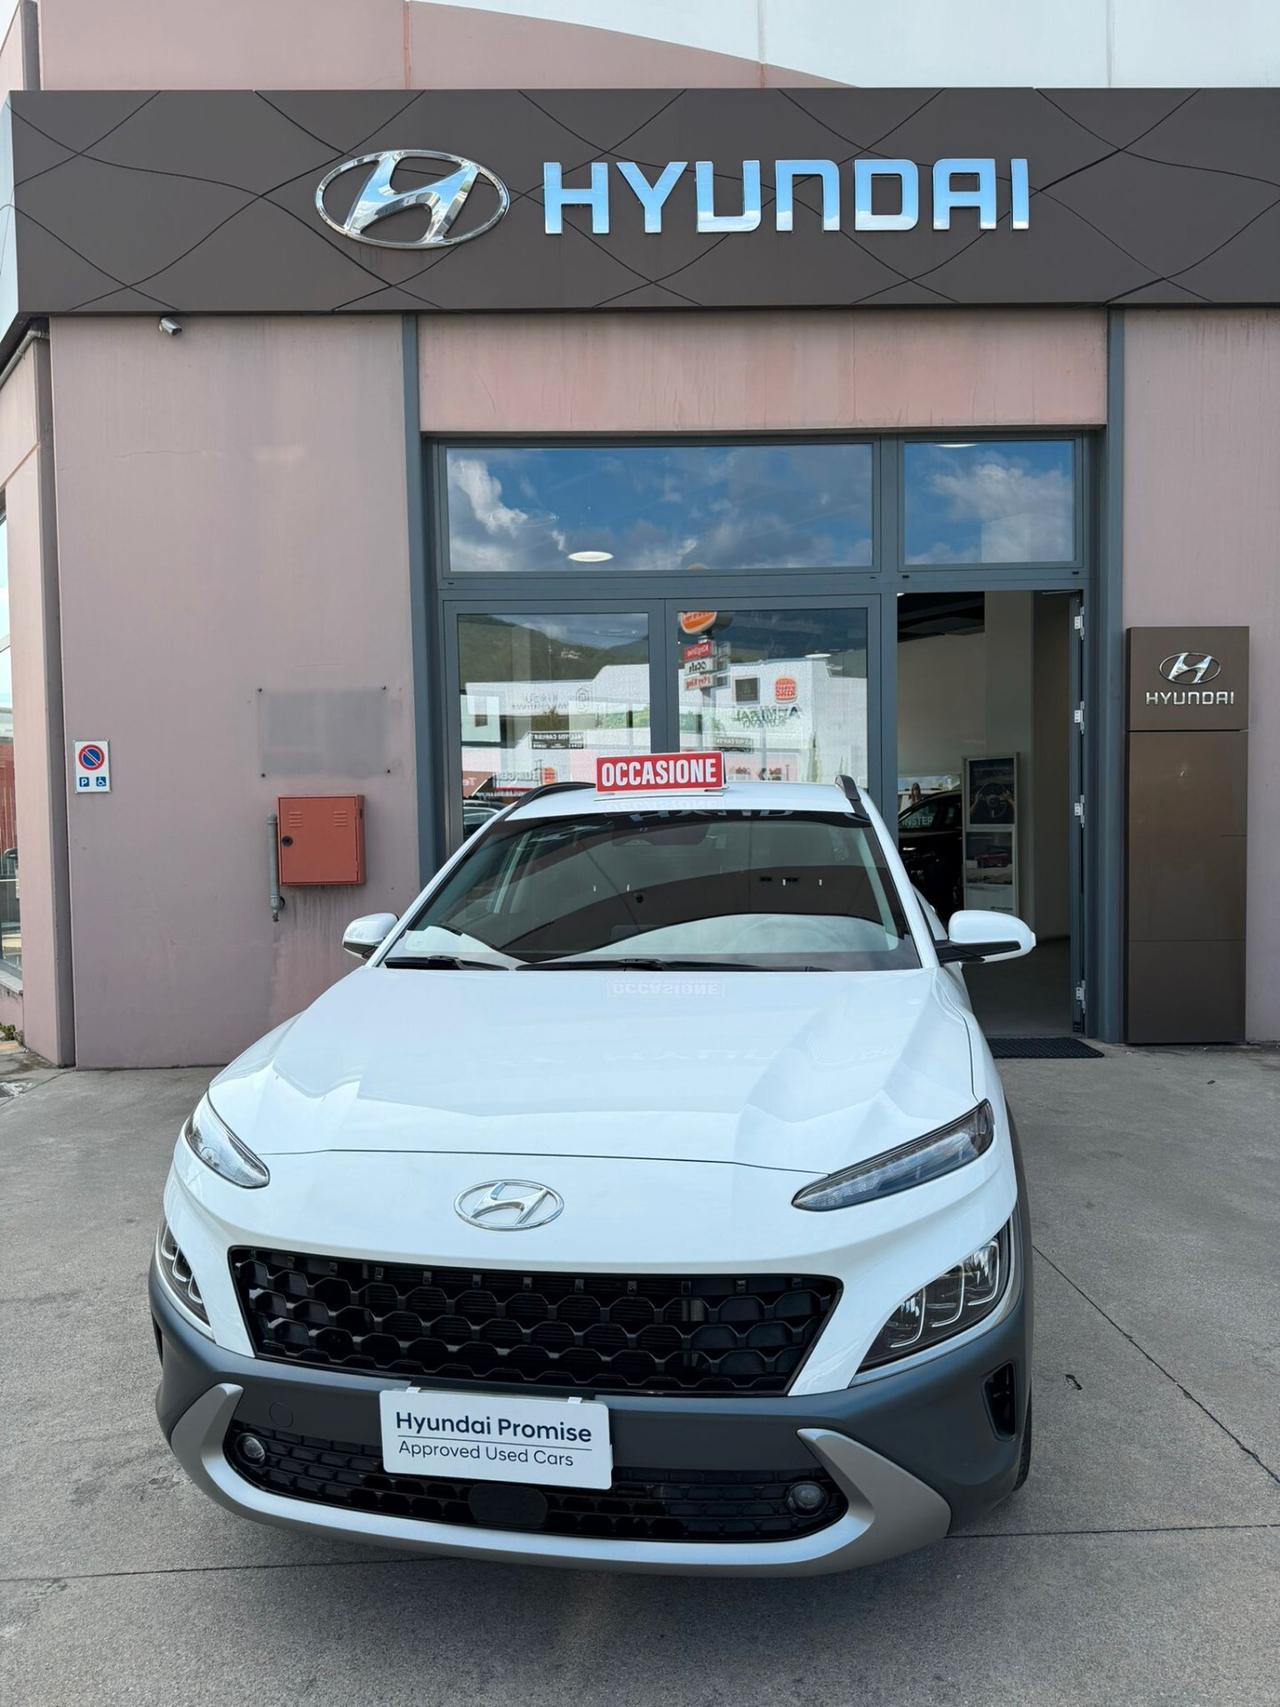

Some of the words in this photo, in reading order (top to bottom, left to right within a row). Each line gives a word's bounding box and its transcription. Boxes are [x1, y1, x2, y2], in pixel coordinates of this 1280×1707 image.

[543, 158, 1029, 235] HYUNDAI
[1145, 691, 1234, 705] HYUNDAI
[601, 758, 718, 787] OCCASIONE
[396, 1411, 491, 1435] Hyundai
[498, 1418, 592, 1443] Promise
[399, 1440, 481, 1459] Approved
[485, 1446, 529, 1463] Used
[534, 1450, 574, 1467] Cars
